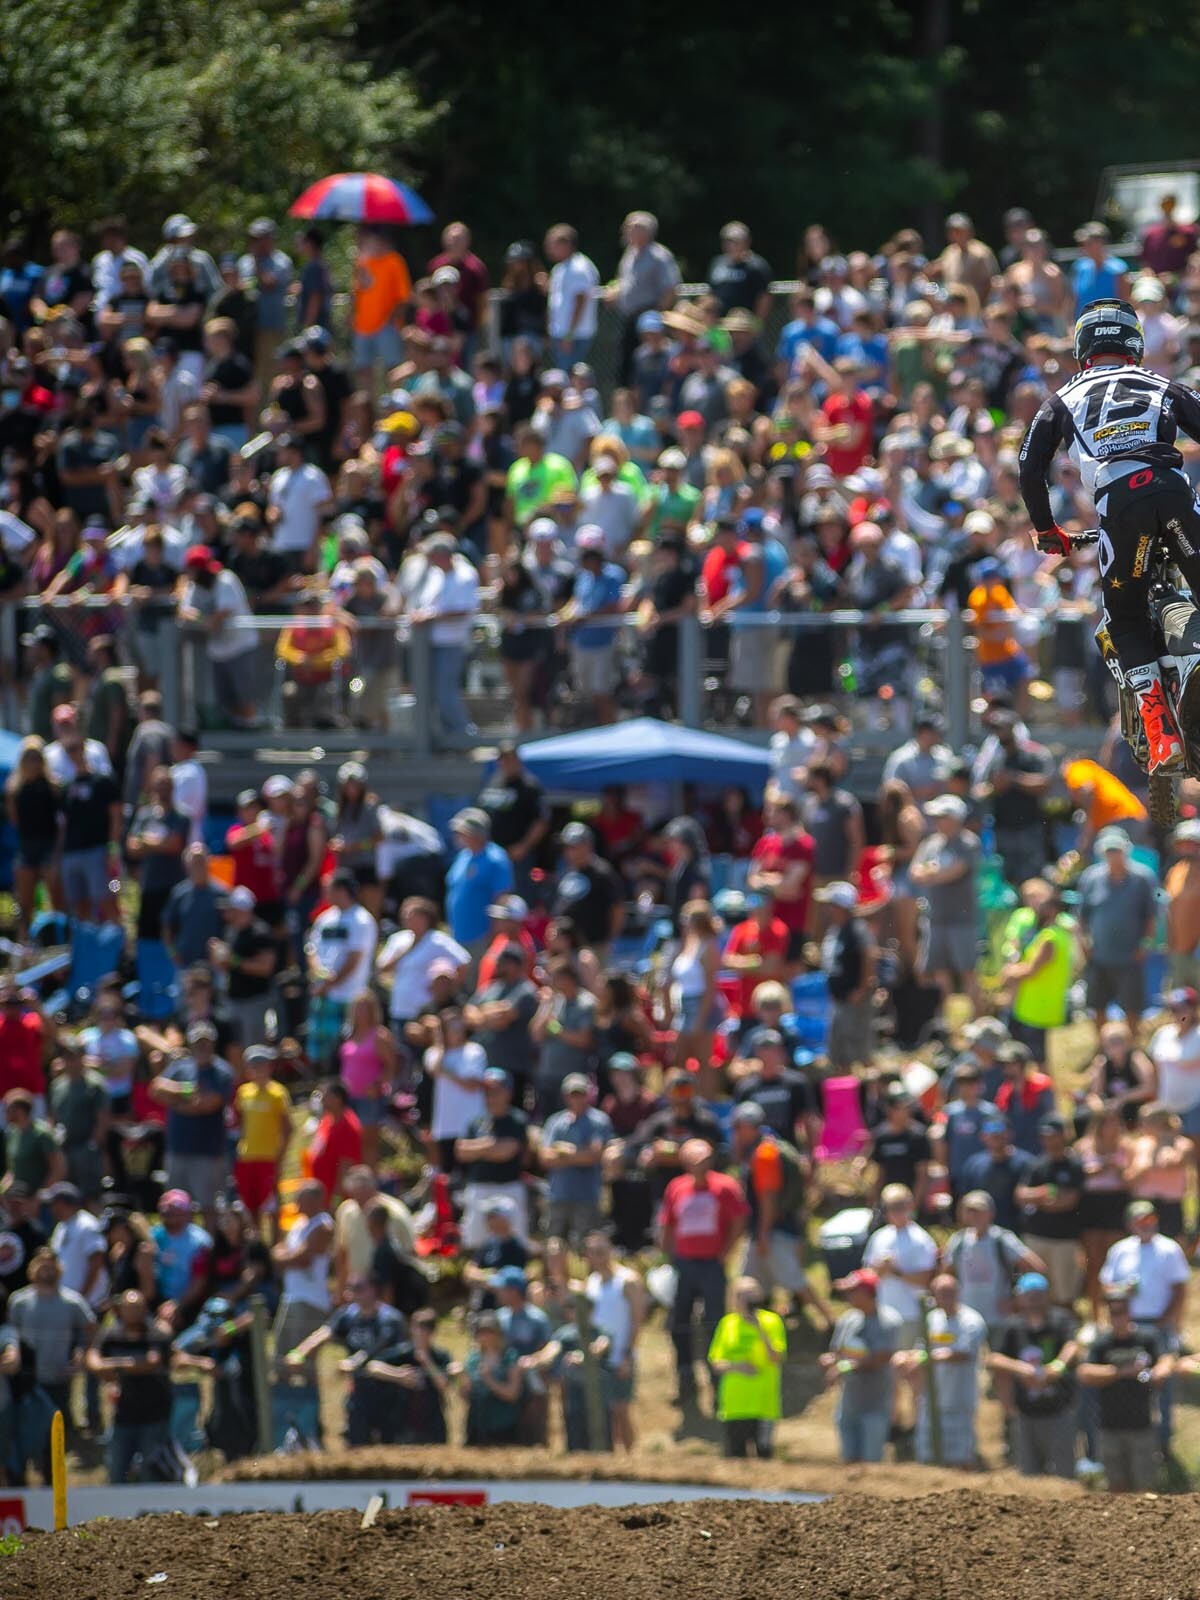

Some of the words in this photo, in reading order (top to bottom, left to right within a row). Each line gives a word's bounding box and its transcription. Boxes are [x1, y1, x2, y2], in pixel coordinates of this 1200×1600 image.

[1083, 378, 1161, 432] 15
[1093, 421, 1151, 442] ROCKSTAR
[1132, 535, 1150, 578] ROCKSTAR
